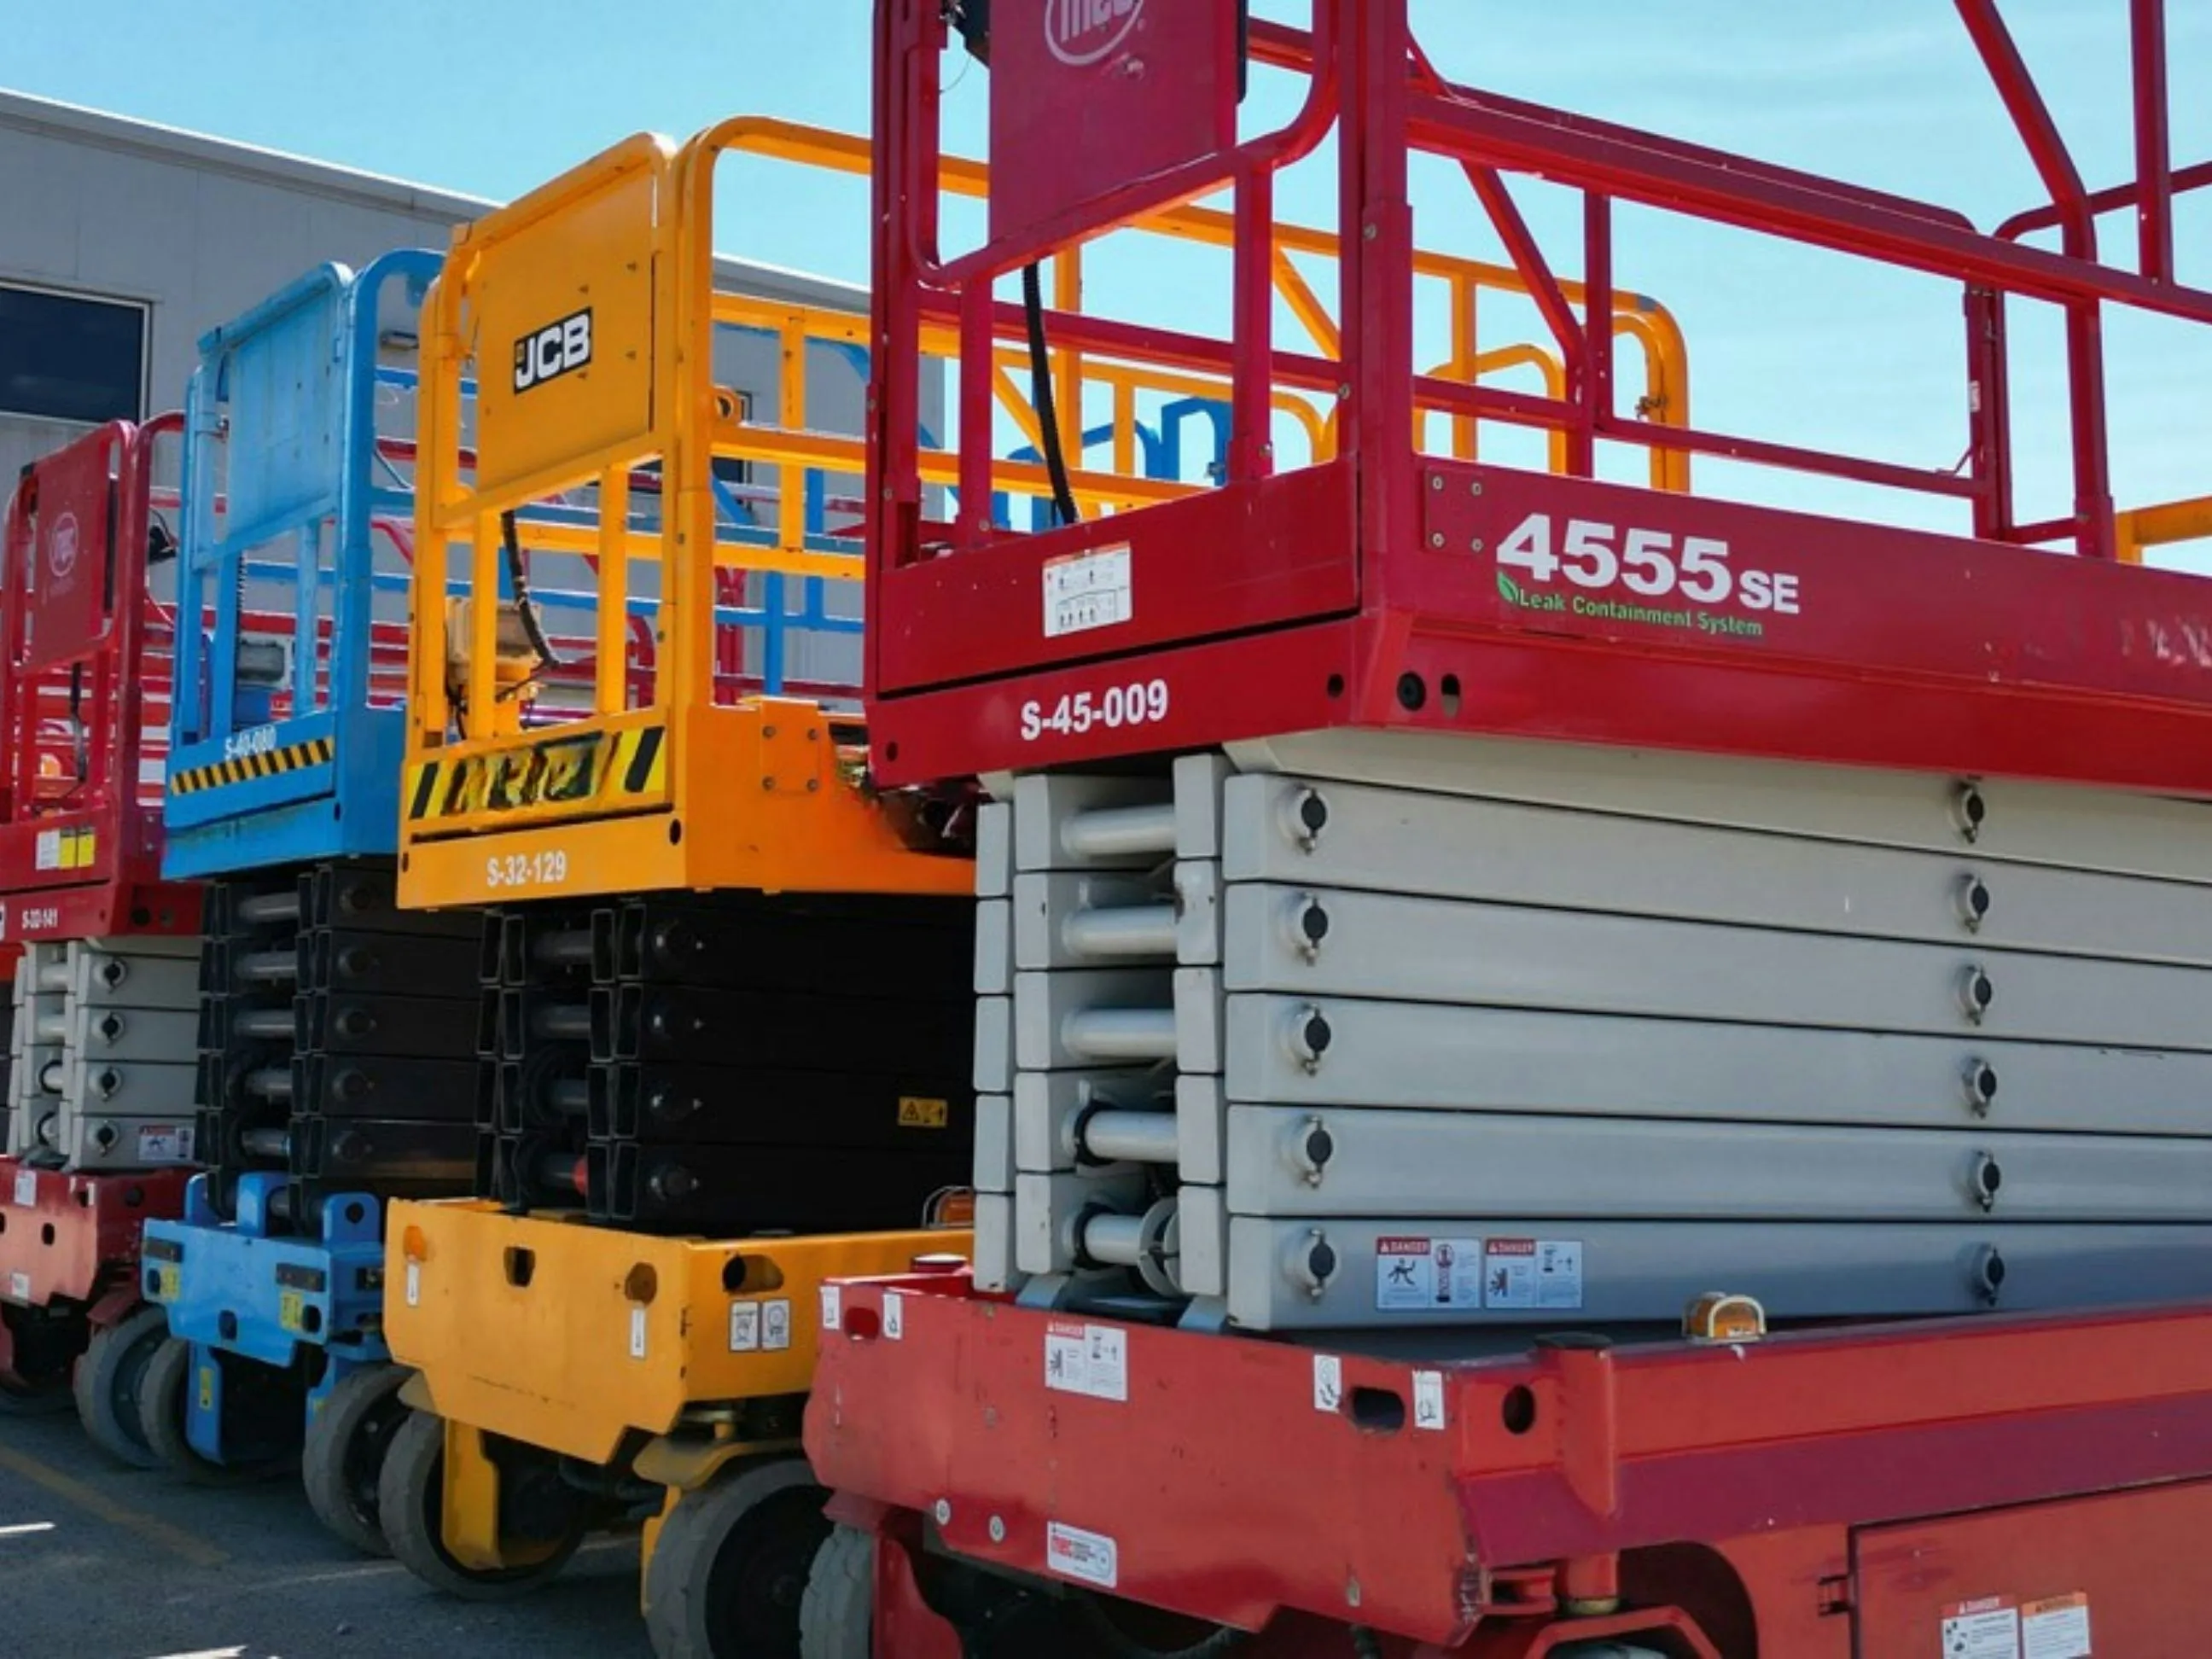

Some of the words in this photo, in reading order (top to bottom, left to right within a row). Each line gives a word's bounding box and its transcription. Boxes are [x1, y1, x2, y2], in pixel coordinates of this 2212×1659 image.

[515, 313, 590, 389] JCB
[1496, 512, 1732, 603] 4555
[1738, 569, 1800, 614] SE
[1519, 588, 1566, 611] Leak
[1572, 596, 1691, 627] Containment
[1697, 610, 1763, 636] System
[1021, 678, 1169, 742] S-45-009
[486, 849, 567, 888] S-32-129
